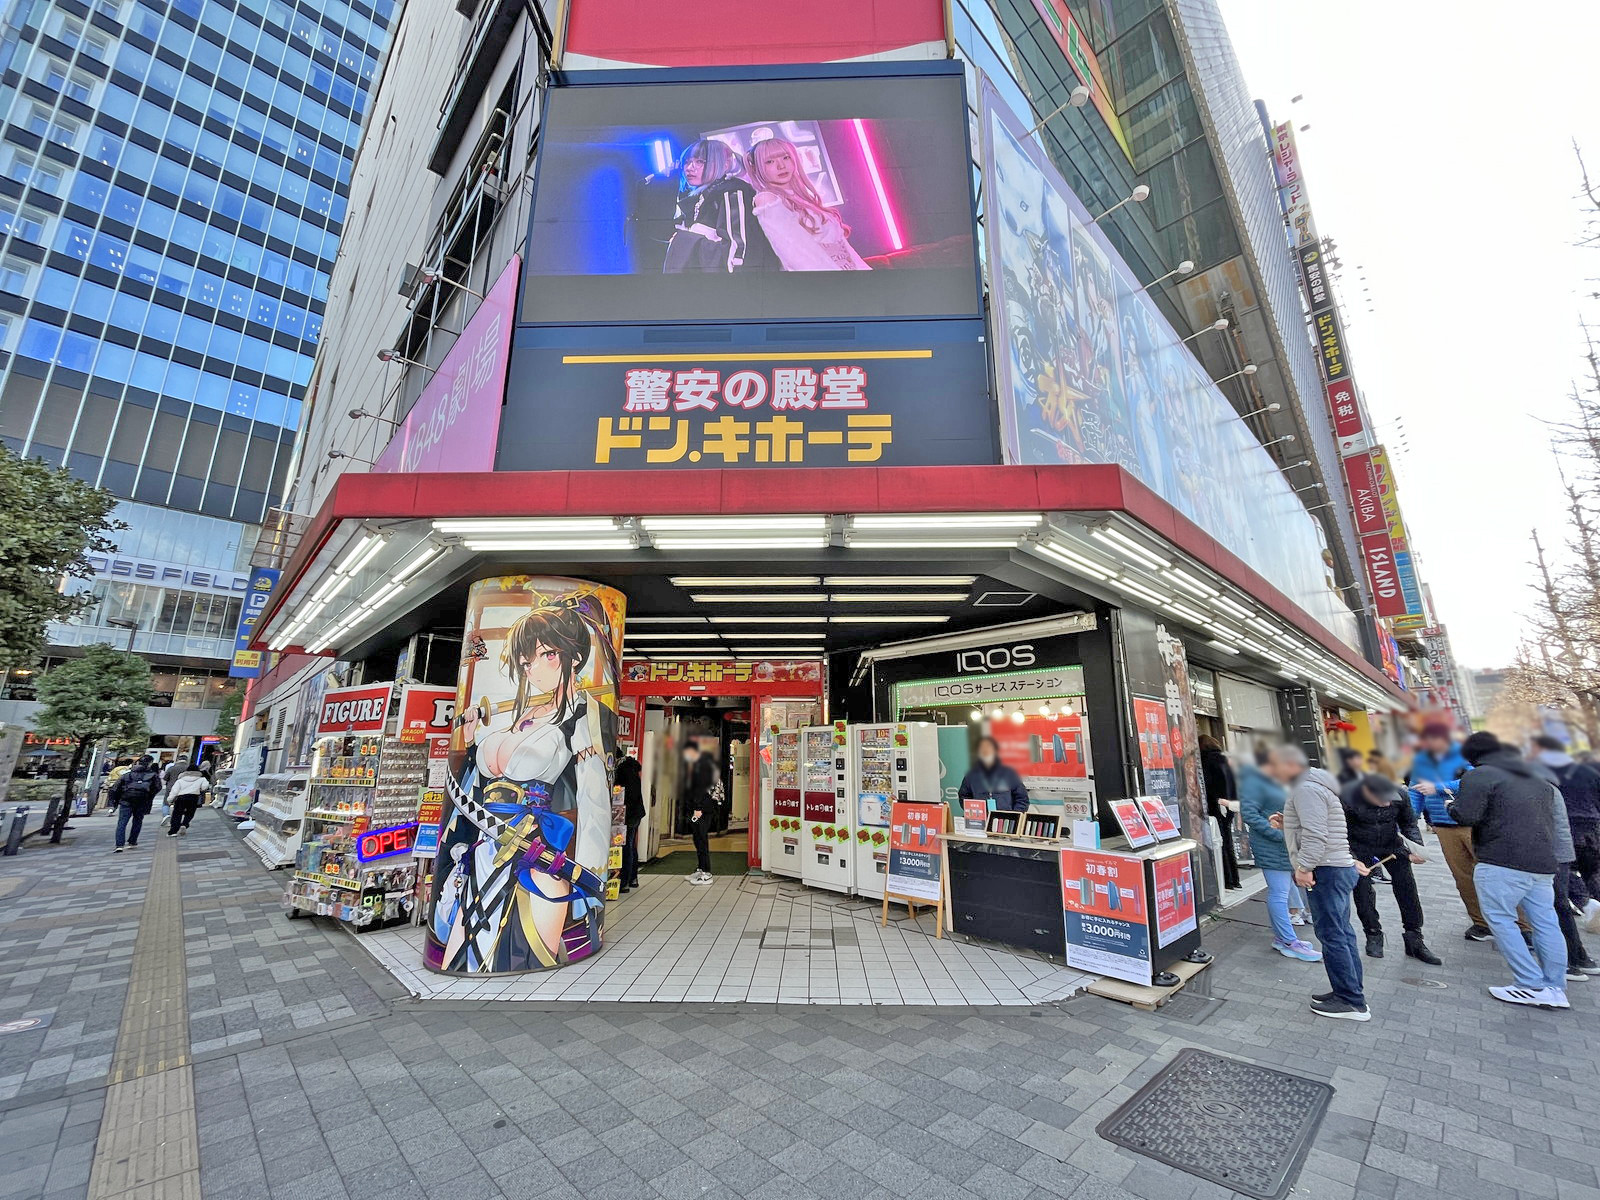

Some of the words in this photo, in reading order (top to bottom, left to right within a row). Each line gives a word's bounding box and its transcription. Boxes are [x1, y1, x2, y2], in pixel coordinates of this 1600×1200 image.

[623, 366, 869, 412] 驚安の殿堂
[1334, 390, 1354, 417] 免税
[1356, 488, 1376, 523] AKIBA
[1369, 546, 1396, 599] ISLAND
[253, 595, 266, 607] P
[957, 644, 1036, 673] IQOS
[321, 697, 384, 725] FIGURE
[907, 811, 929, 822] 初春割
[1085, 862, 1119, 879] 初春割
